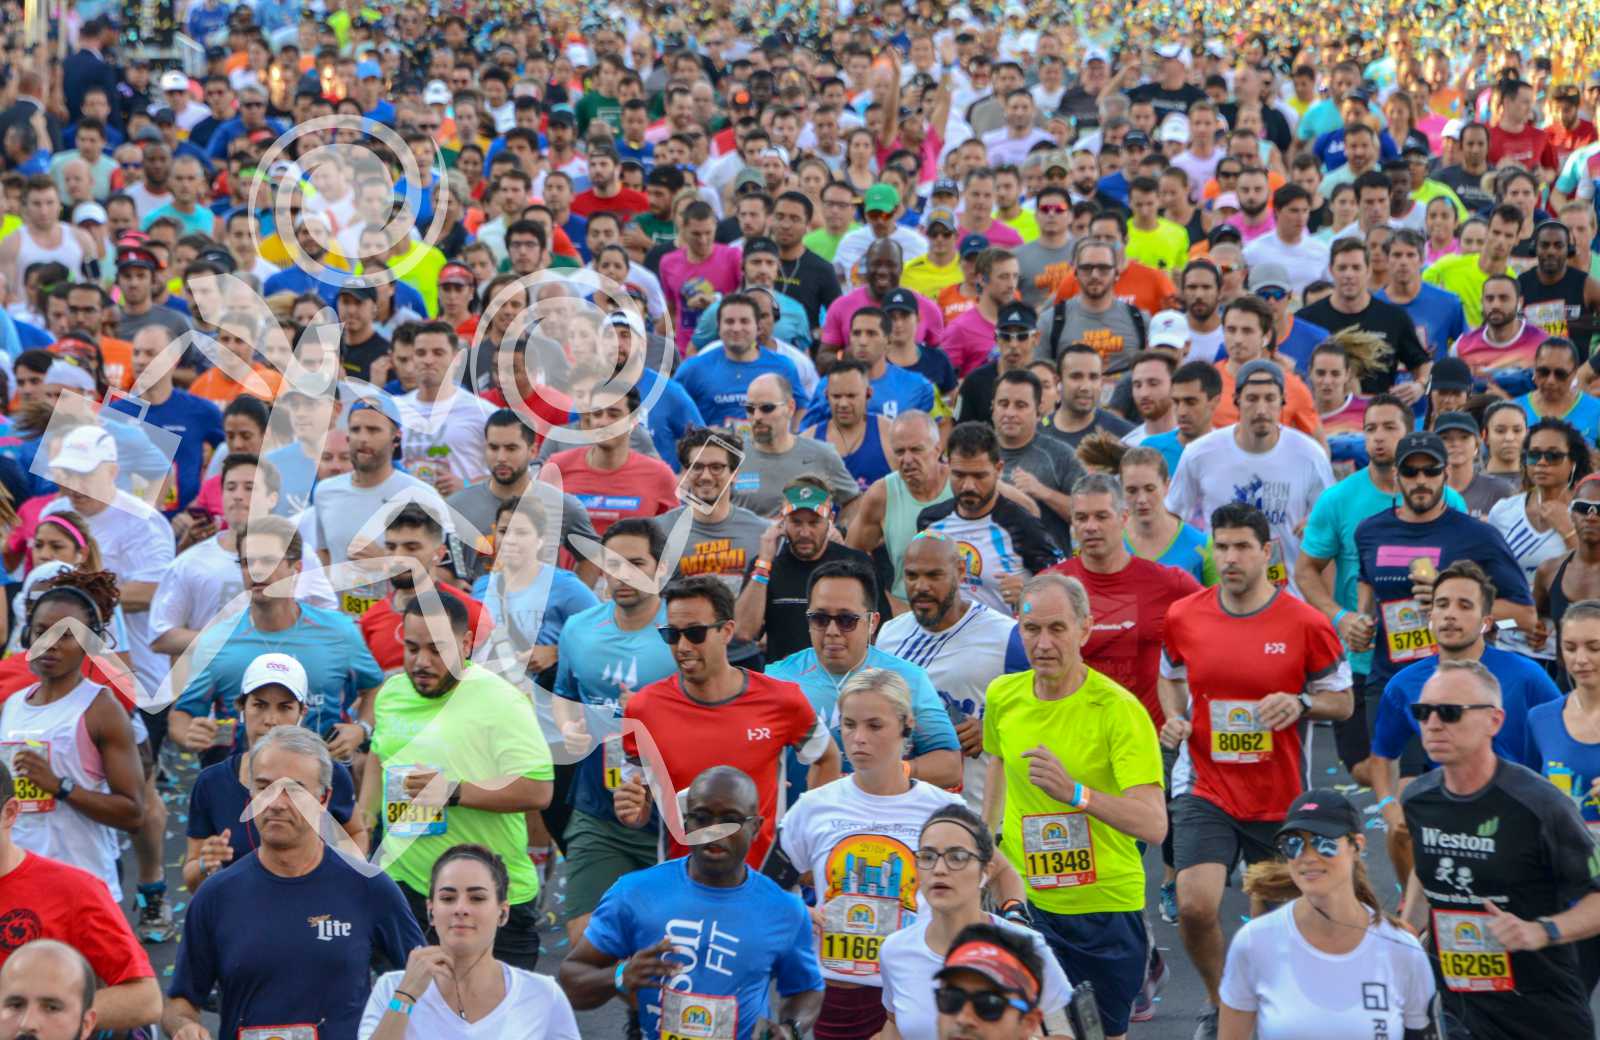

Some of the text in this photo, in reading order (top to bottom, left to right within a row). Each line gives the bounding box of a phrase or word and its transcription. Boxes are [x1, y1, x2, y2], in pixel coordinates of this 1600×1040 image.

[695, 538, 731, 554] TEAM
[680, 548, 746, 576] MIAMI
[346, 594, 380, 614] 891
[1264, 642, 1287, 655] HDR
[1393, 627, 1433, 651] 5781
[746, 726, 771, 741] HDR
[1218, 731, 1264, 753] 8062
[1421, 826, 1496, 853] Weston
[1027, 848, 1091, 876] 11348
[316, 919, 352, 941] Lite
[705, 920, 741, 977] FIT
[825, 934, 886, 961] 1166
[1441, 952, 1506, 978] 16265
